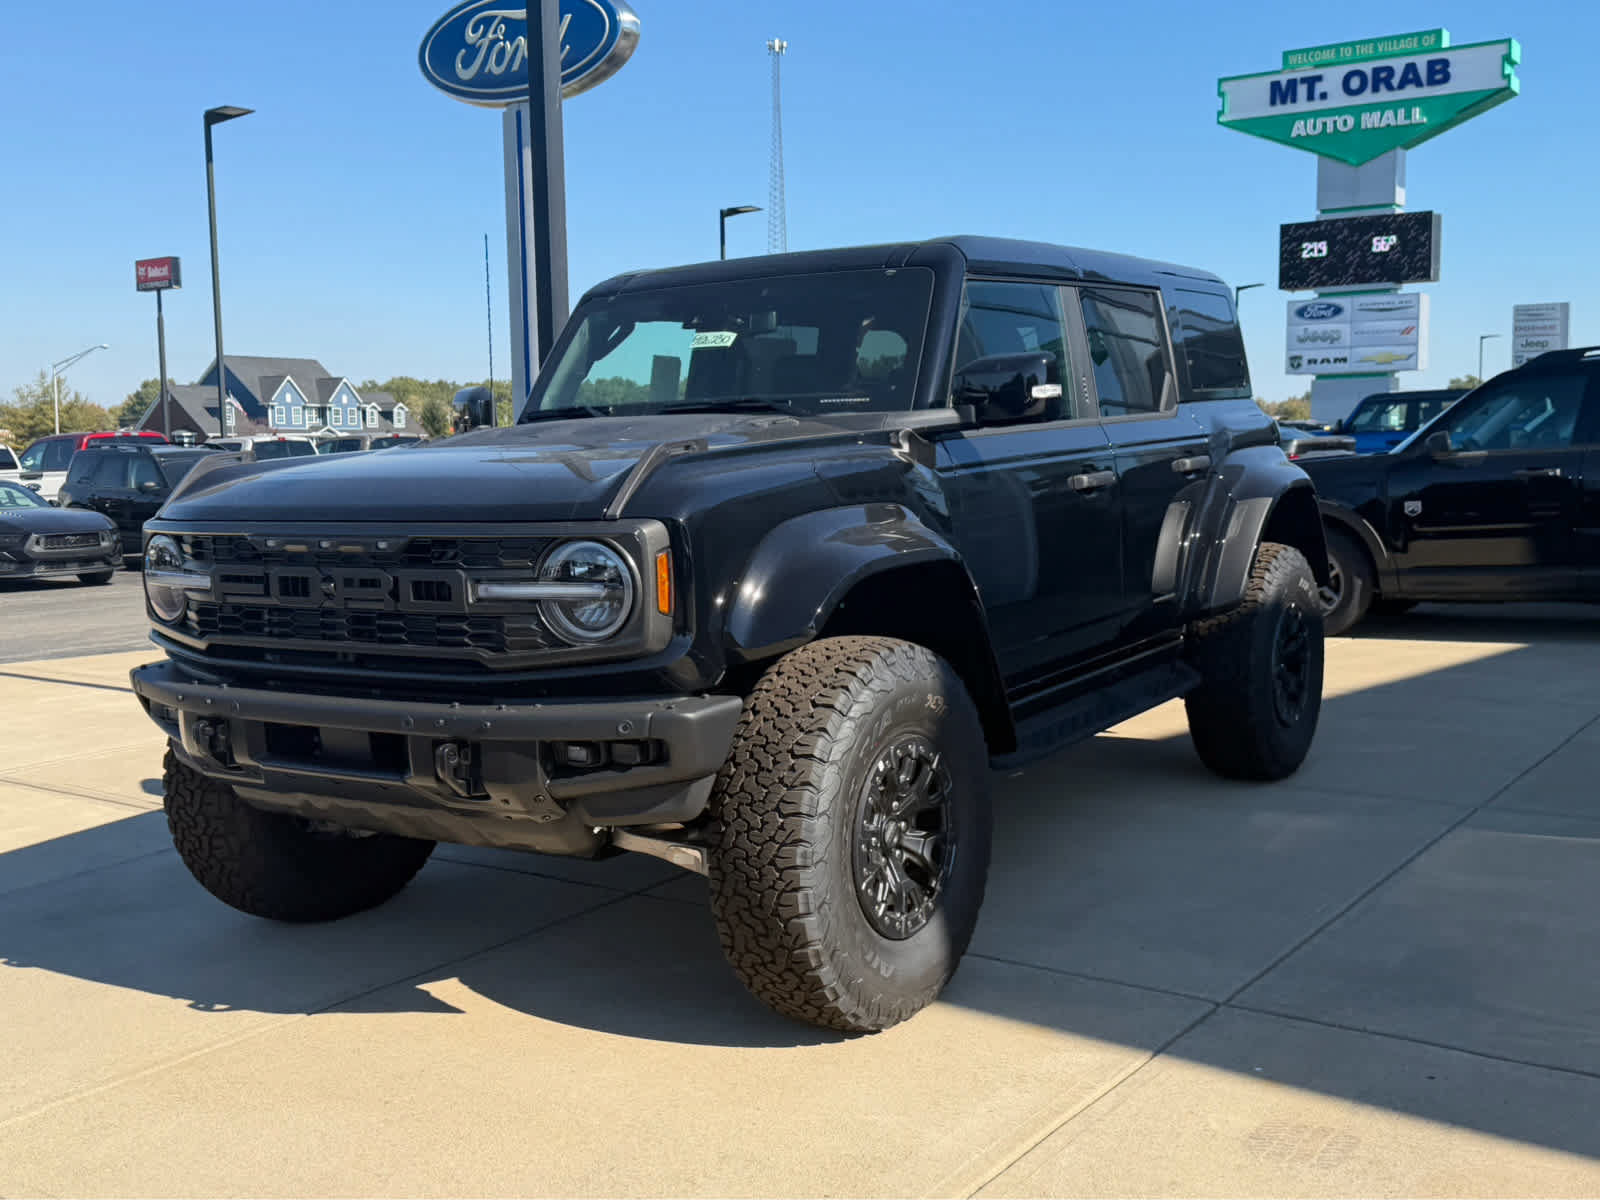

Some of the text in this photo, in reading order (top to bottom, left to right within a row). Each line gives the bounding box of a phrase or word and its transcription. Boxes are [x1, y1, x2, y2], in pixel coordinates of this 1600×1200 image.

[1289, 34, 1436, 64] WELCOME TO THE VILLAGE OF
[1269, 58, 1451, 107] MT. ORAB
[1290, 107, 1427, 138] AUTO MALL
[1303, 303, 1336, 318] Ford
[1297, 328, 1341, 344] Jeep
[1521, 338, 1549, 350] Jeep
[1307, 356, 1347, 365] RAM
[211, 565, 468, 613] FORD
